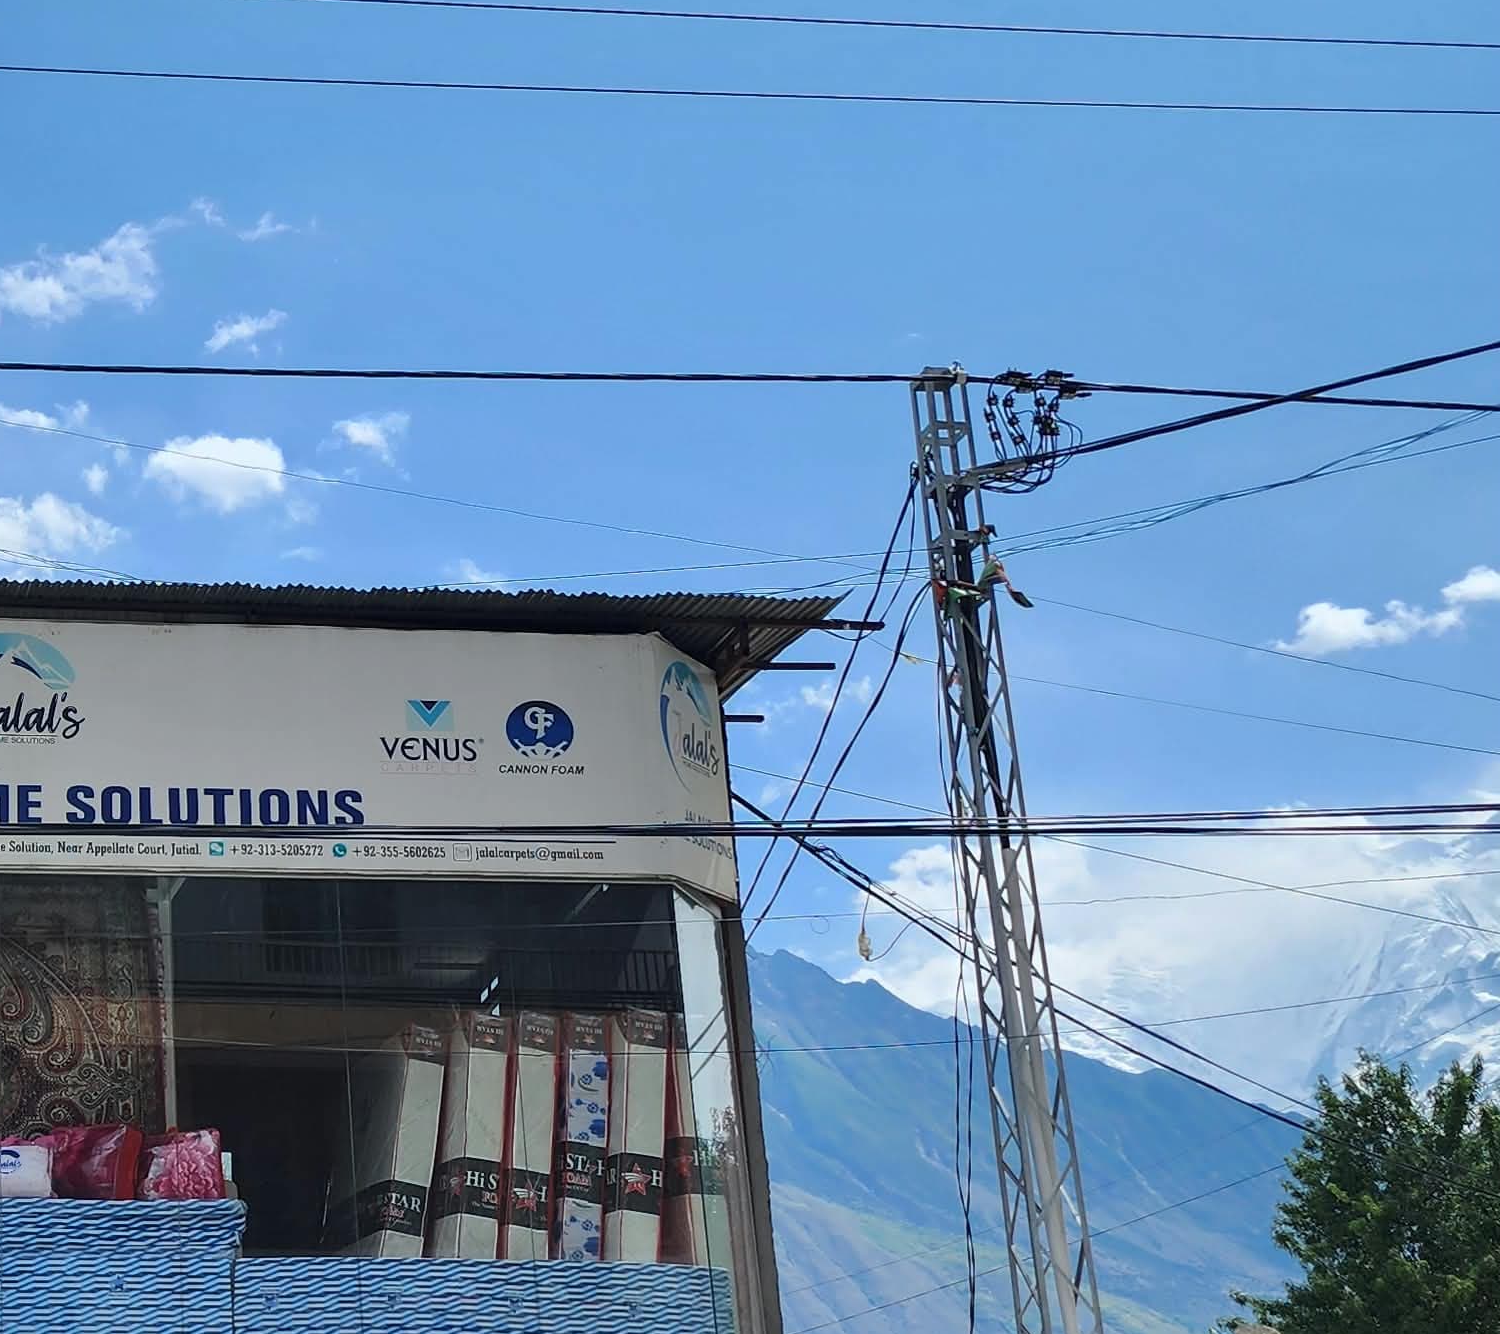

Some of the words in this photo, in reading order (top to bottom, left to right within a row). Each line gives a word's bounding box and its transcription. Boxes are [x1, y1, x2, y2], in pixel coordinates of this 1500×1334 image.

[11, 736, 56, 745] SOLUTIONS
[379, 737, 478, 762] VENUS
[499, 764, 548, 775] CANNON
[551, 765, 585, 775] FOAM
[65, 784, 365, 827] SOLUTIONS
[8, 840, 55, 855] Solution,
[57, 841, 83, 854] Near
[85, 841, 134, 857] Appellate
[136, 842, 168, 856] Court,
[171, 843, 202, 856] Jutial.
[229, 844, 324, 857] +92-313-5205272
[352, 845, 446, 859] +92-355-5602625
[475, 847, 604, 862] jalalcarpets@gmail.com
